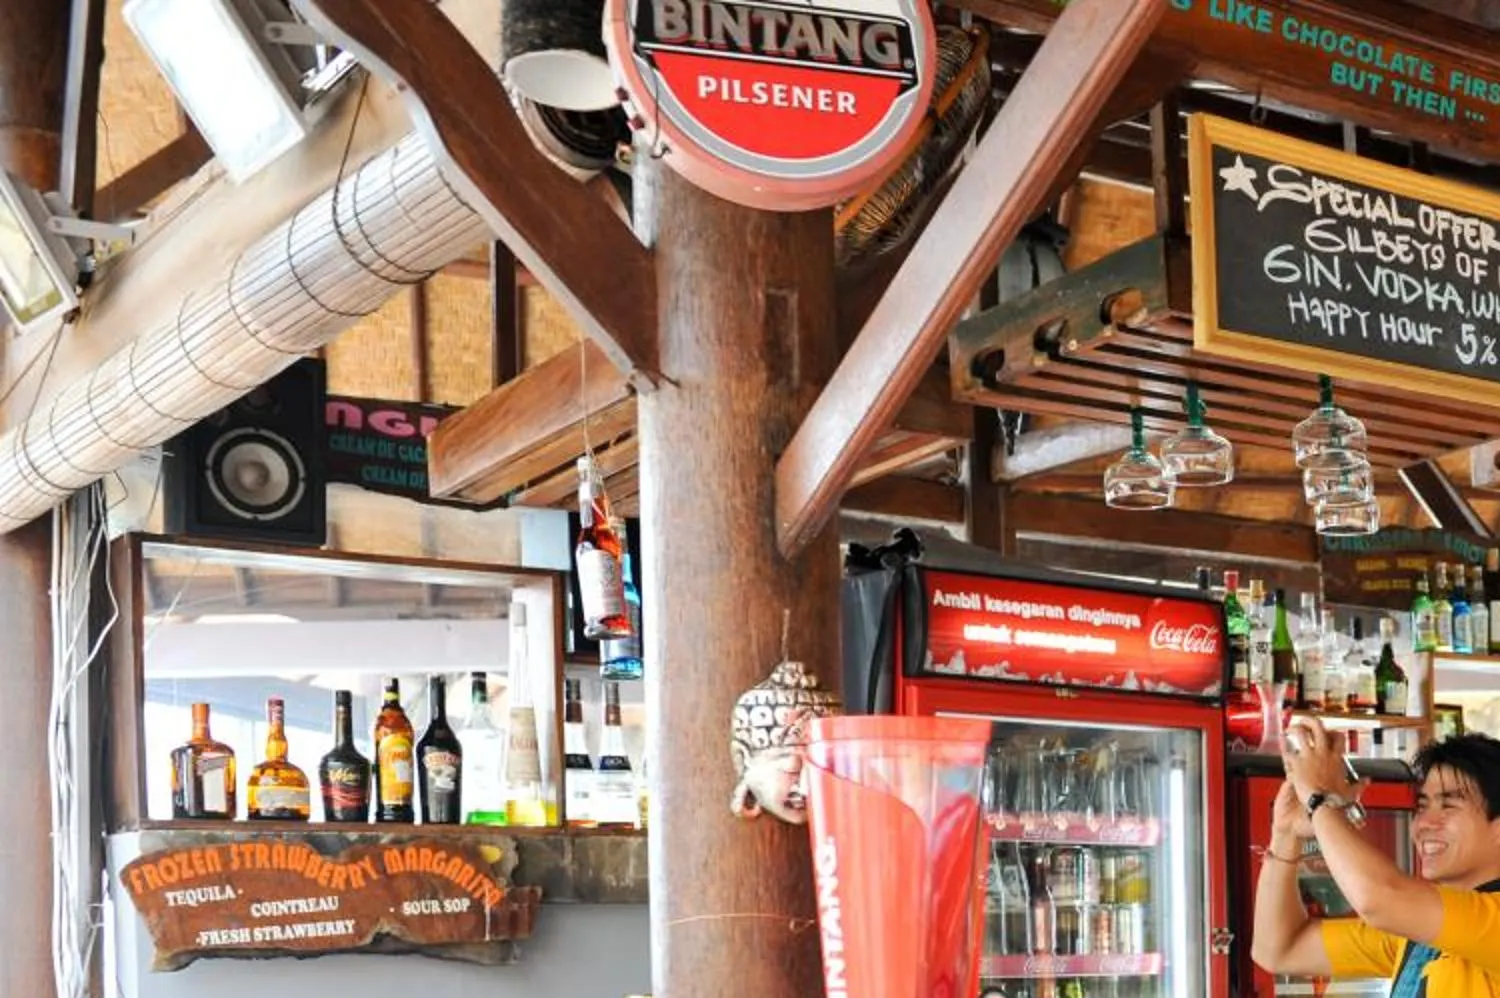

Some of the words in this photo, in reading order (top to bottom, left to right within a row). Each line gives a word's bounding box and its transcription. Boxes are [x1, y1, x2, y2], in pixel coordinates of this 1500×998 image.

[652, 0, 900, 68] BINTANG
[1209, 0, 1273, 33] LIKE
[1282, 16, 1435, 84] CHOCOLATE
[697, 75, 858, 115] PILSENER
[1330, 62, 1383, 96] BUT
[1391, 80, 1457, 119] THEN
[1257, 164, 1416, 229] SPECIAL
[1455, 252, 1488, 285] OF
[933, 589, 981, 611] Ambil
[984, 594, 1066, 619] kesegaran
[129, 848, 222, 895] FROZEN
[229, 840, 379, 891] STRAWBERRY
[164, 884, 236, 908] TEQUILA
[251, 895, 340, 918] COINTREAU
[402, 899, 442, 916] SOUR
[444, 897, 471, 914] SOP
[253, 919, 356, 942] STRAWBERRY
